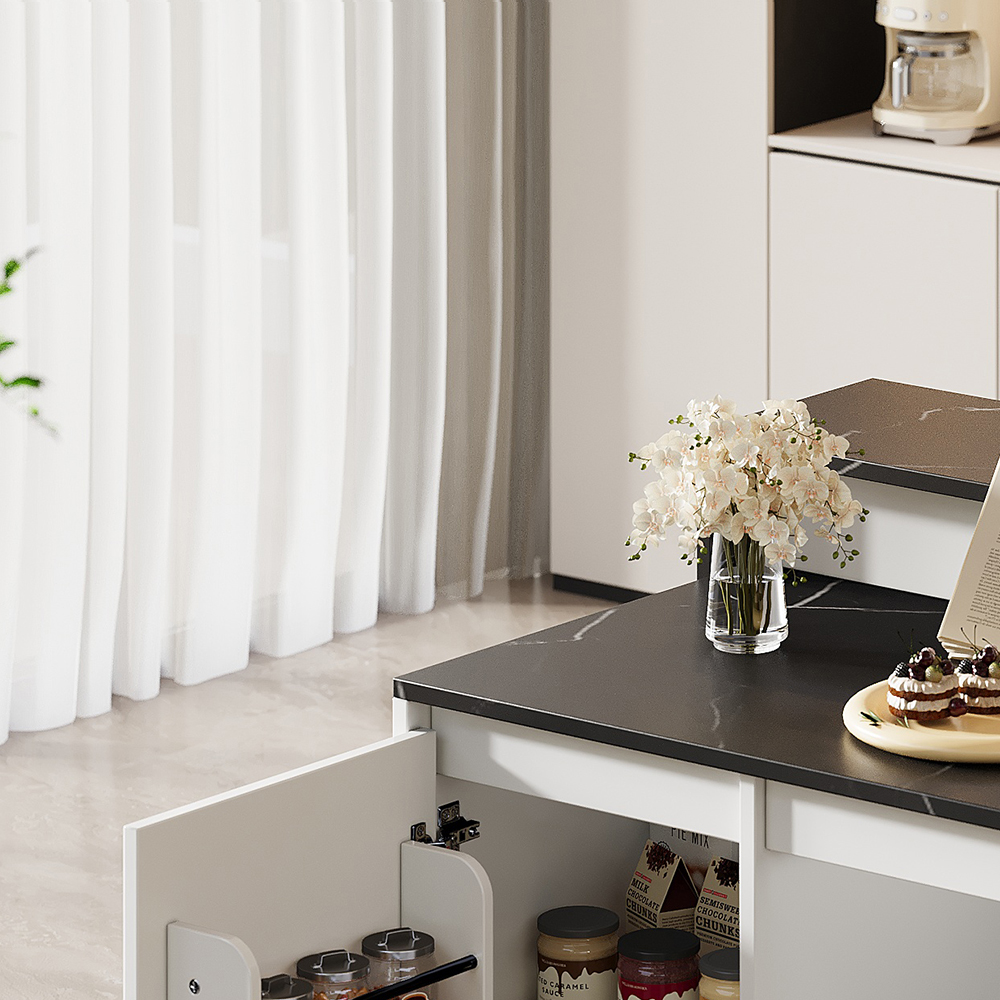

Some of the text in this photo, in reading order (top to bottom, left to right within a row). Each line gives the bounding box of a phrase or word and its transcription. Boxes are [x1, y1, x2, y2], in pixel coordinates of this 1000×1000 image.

[671, 827, 710, 848] PIE MIX
[630, 878, 650, 894] MILK
[627, 888, 660, 912] CHOCOLATE
[626, 898, 658, 923] CHUNKS
[697, 906, 739, 925] CHOCOLAT
[541, 986, 564, 997] SAUCE
[549, 981, 589, 990] CARAMEL
